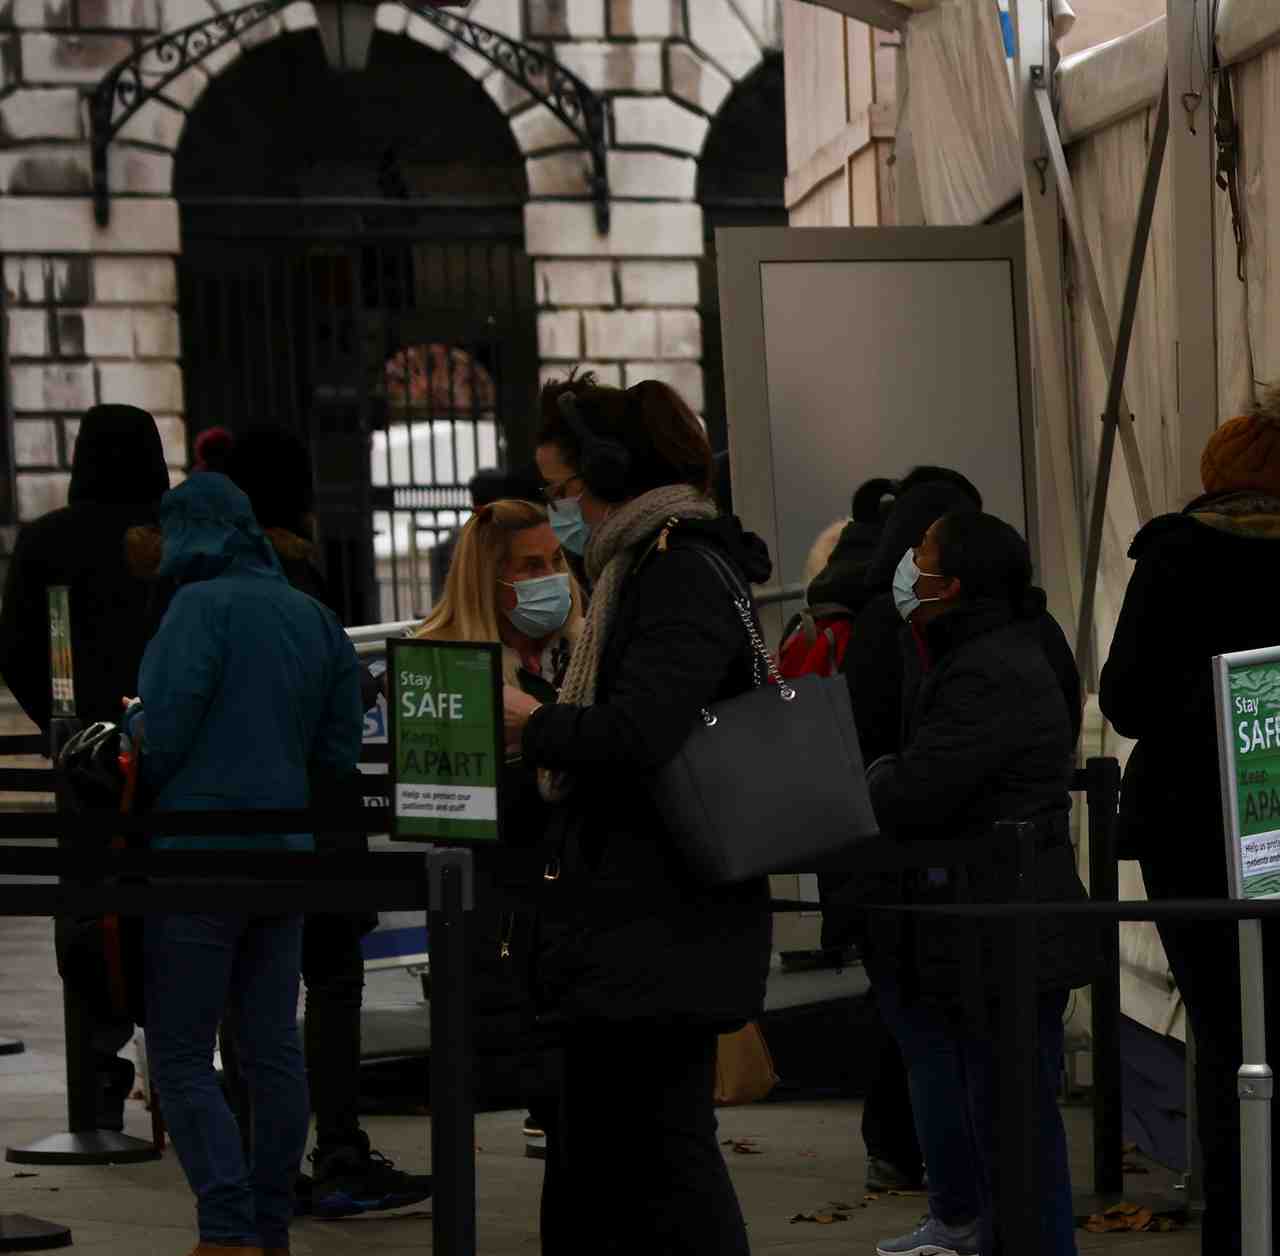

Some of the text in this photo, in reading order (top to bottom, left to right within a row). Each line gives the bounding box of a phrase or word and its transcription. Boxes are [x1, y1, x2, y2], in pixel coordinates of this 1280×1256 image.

[400, 671, 432, 690] Stay
[402, 692, 463, 719] SAFE
[1235, 696, 1259, 715] Stay
[402, 750, 488, 776] APART
